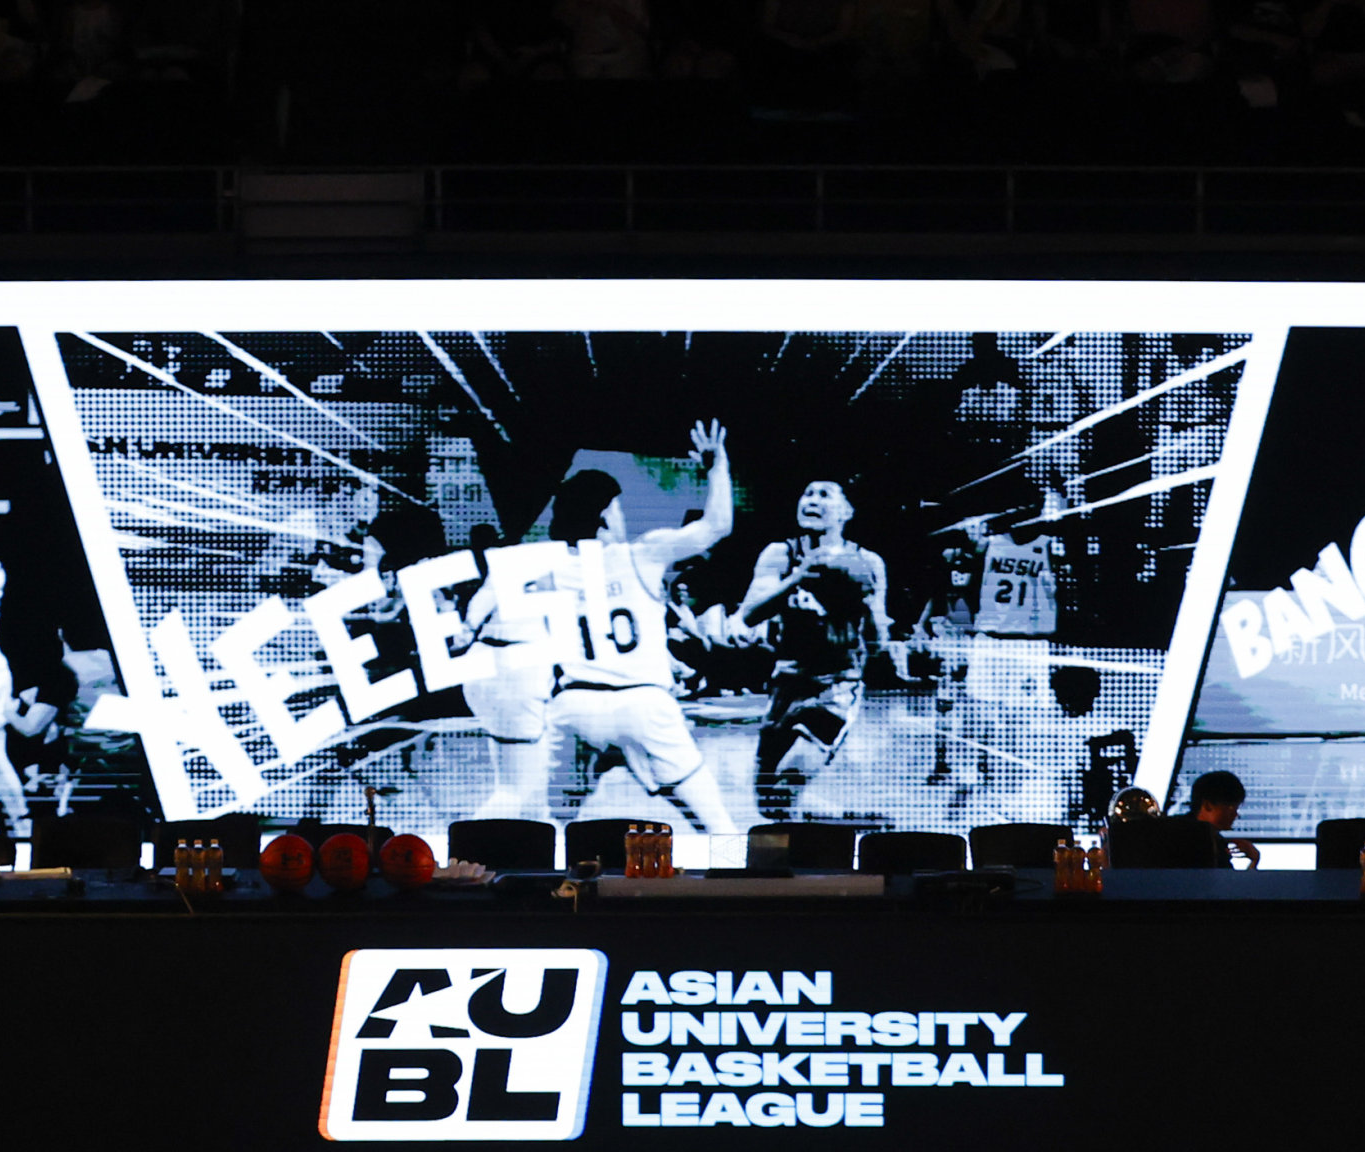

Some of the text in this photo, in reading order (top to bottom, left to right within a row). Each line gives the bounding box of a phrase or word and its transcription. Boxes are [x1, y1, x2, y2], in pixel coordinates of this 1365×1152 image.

[995, 579, 1028, 607] 21
[622, 970, 832, 1006] ASIAN
[622, 1011, 1028, 1047] UNIVERSITY
[352, 1048, 561, 1122] BL
[622, 1052, 1064, 1088] BASKETBALL
[622, 1092, 884, 1127] LEAGUE
